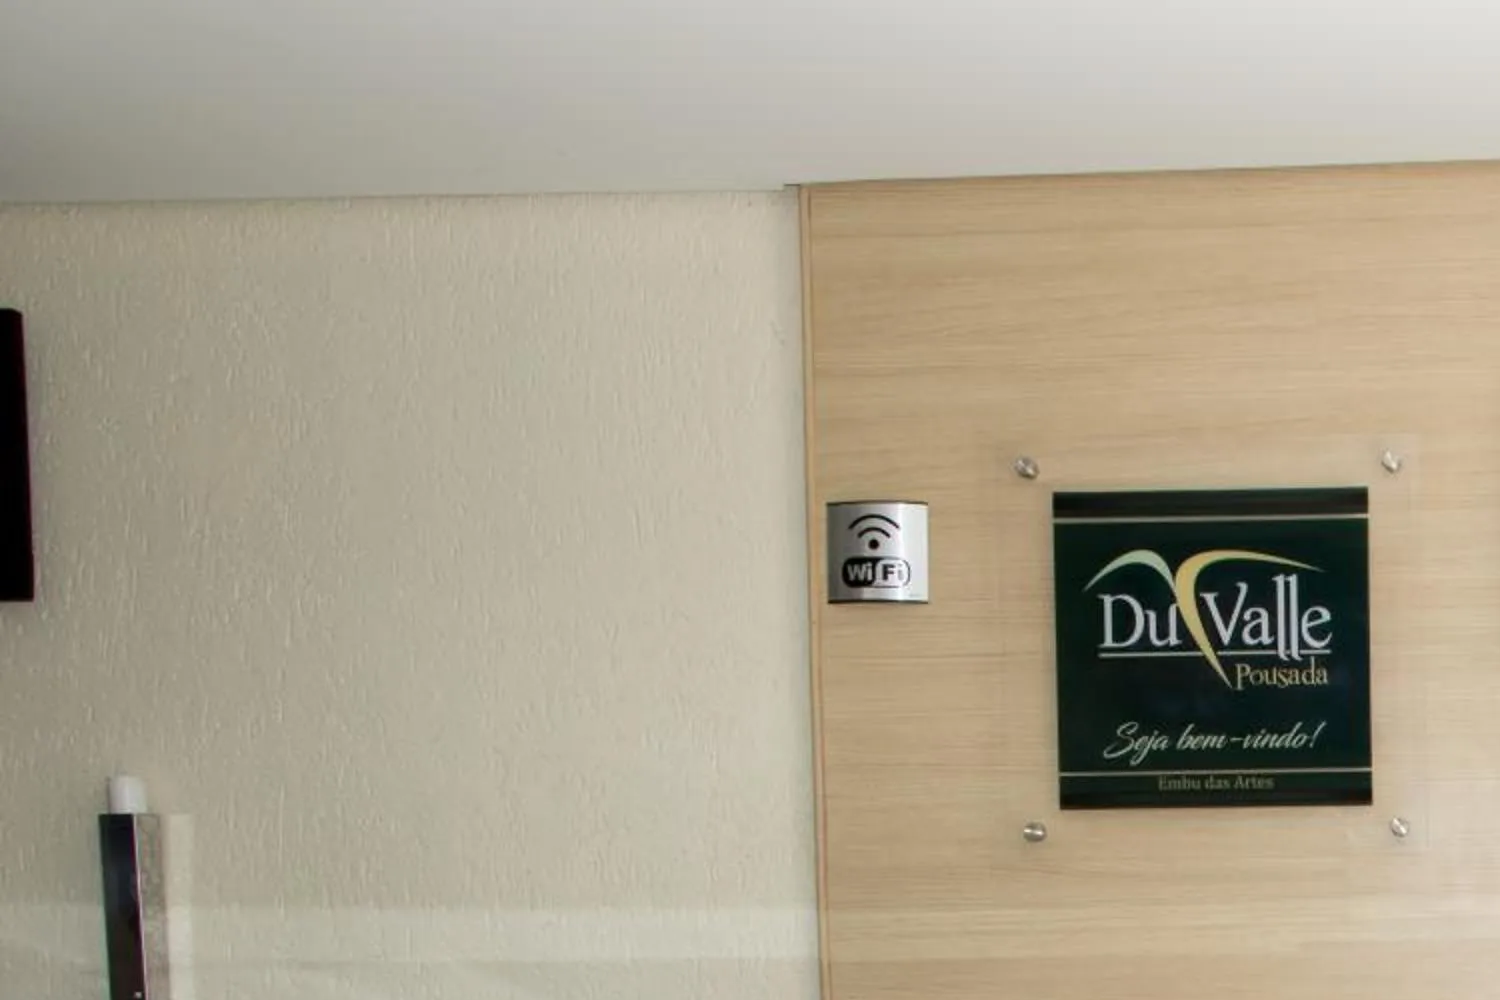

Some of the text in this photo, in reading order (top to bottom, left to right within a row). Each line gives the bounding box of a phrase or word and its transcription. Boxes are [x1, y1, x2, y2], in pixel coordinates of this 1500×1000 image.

[1234, 656, 1329, 691] Pousada
[1103, 721, 1169, 766] Seja
[1158, 774, 1275, 790] Embu das Artes
